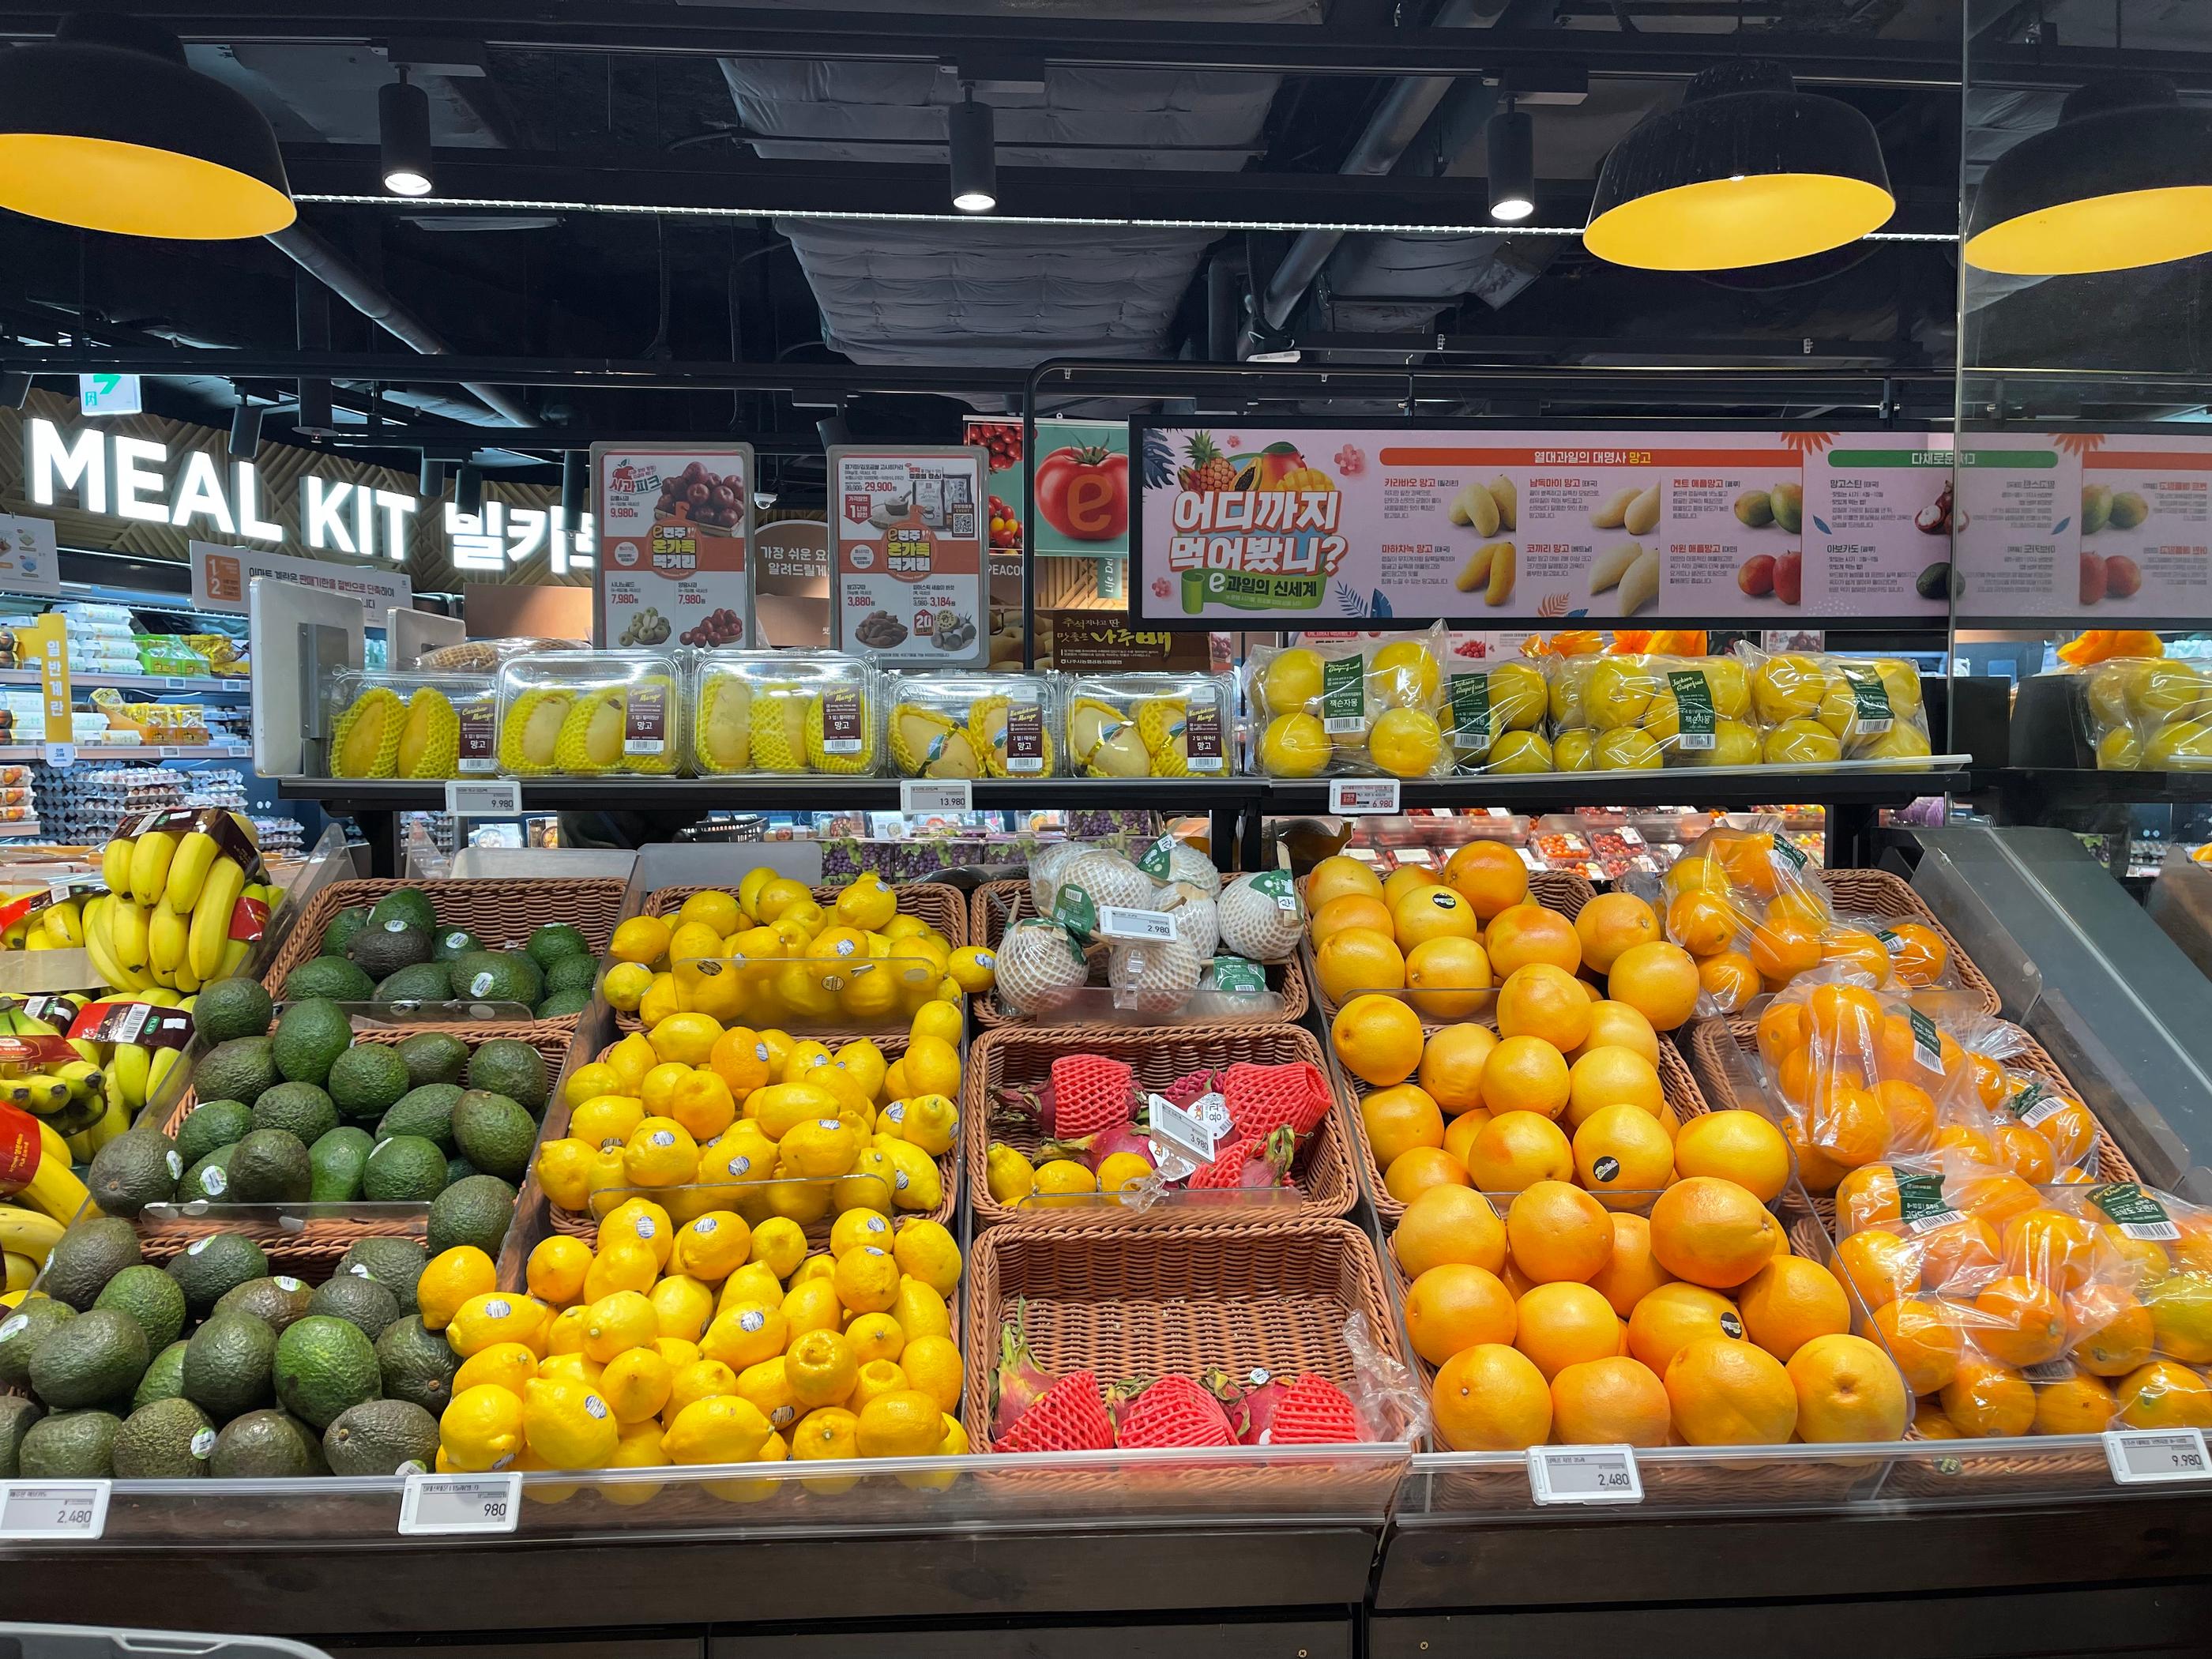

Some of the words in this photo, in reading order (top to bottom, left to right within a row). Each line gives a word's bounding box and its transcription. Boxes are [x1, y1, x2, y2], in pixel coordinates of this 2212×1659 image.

[1534, 451, 1589, 464] 열대과일의
[1593, 451, 1627, 464] 대명사
[1629, 451, 1651, 464] 망고
[32, 417, 283, 543] MEAL
[307, 476, 416, 561] KIT
[609, 474, 662, 493] 사과피크
[1384, 478, 1416, 487] 카라바오
[1420, 478, 1435, 487] 망고
[1564, 478, 1580, 487] 망고
[1673, 479, 1689, 488] 켄트
[1691, 479, 1723, 488] 애플망고
[1830, 480, 1862, 488] 망고스틴
[1067, 474, 1113, 532] e
[1173, 491, 1341, 531] 어디까지
[652, 539, 697, 554] 온가족
[887, 541, 931, 556] 온가족
[1382, 544, 1414, 553] 마하차녹
[1416, 544, 1432, 553] 망고
[1527, 544, 1551, 553] 코끼리
[1553, 544, 1569, 553] 망고
[1688, 544, 1721, 553] 애플망고
[1826, 544, 1859, 553] 아보카도
[760, 546, 784, 559] 가장
[788, 547, 811, 561] 쉬운
[1170, 536, 1347, 574] 먹어봤니?
[653, 554, 697, 570] 먹거리
[887, 557, 931, 571] 먹거리
[367, 584, 395, 597] 단축하여
[1104, 577, 1115, 593] Life
[1273, 581, 1317, 597] 신세계
[1062, 617, 1085, 630] 추석
[1108, 618, 1121, 628] 딴
[1330, 698, 1359, 708] 잭슨자몽
[637, 721, 653, 731] 망고
[834, 720, 850, 731] 망고
[470, 740, 486, 750] 망고
[1017, 741, 1033, 751] 망고
[1197, 742, 1212, 750] 망고
[1209, 1102, 1221, 1123] 용과
[484, 1503, 506, 1517] 980
